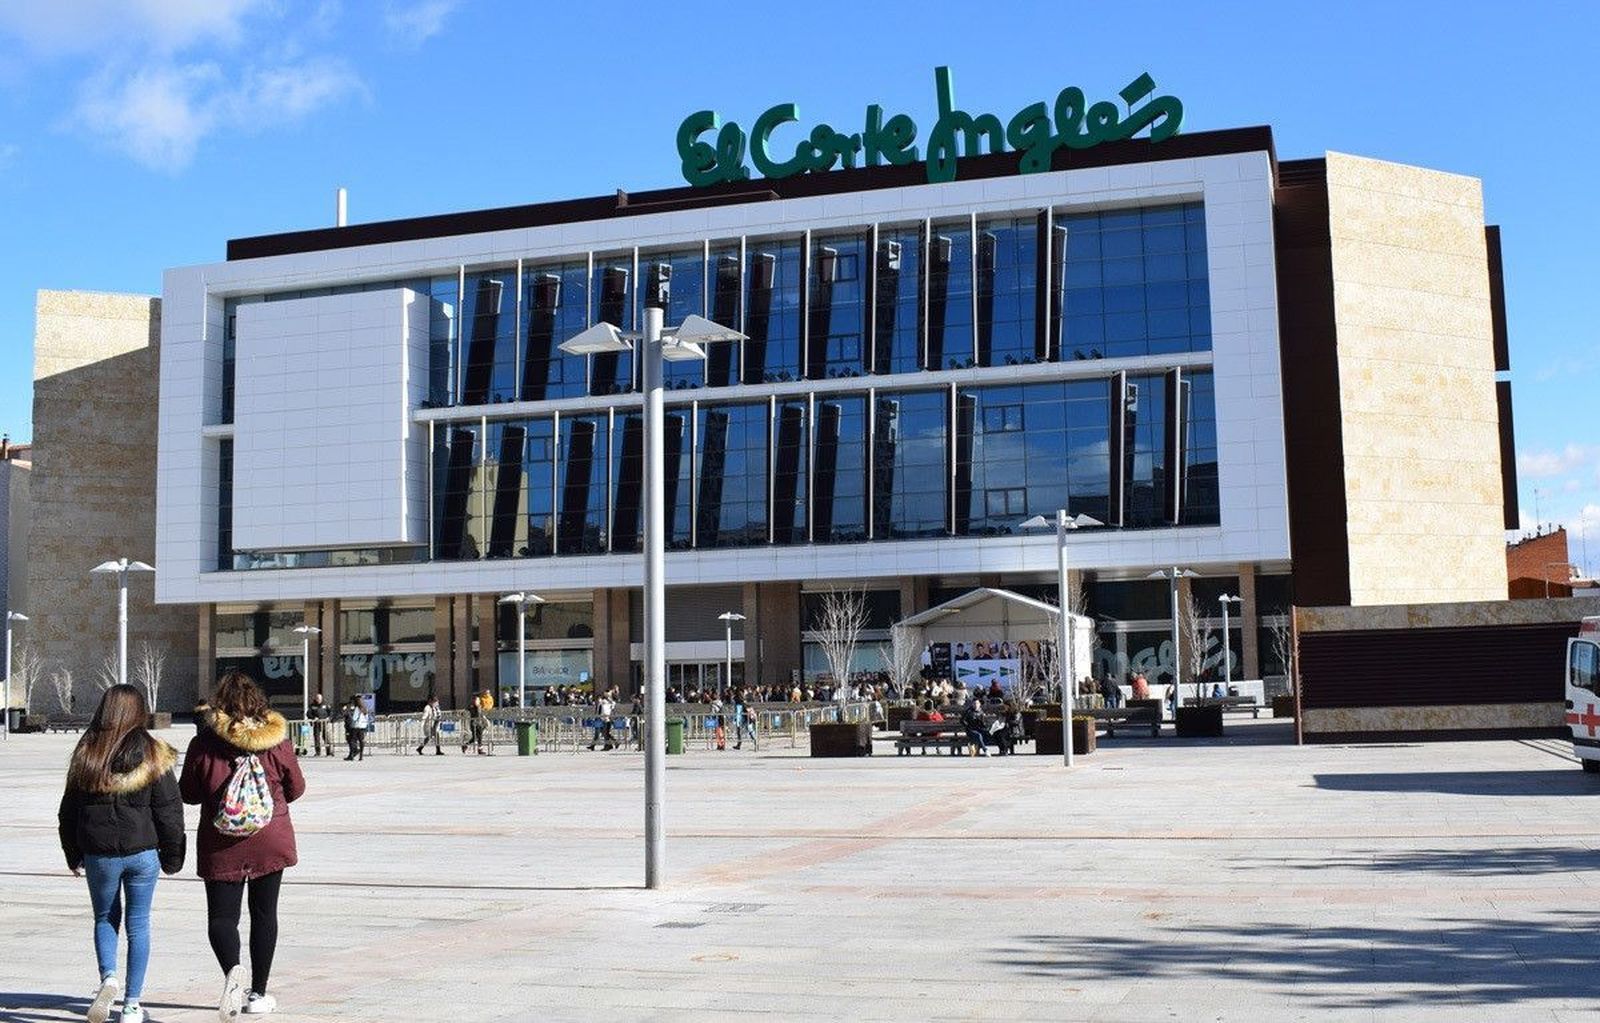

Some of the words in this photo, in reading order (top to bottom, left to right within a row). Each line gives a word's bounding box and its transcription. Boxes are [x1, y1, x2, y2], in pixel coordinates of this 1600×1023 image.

[676, 110, 750, 188] El
[750, 103, 919, 180] Corte
[926, 66, 1184, 184] Inglés
